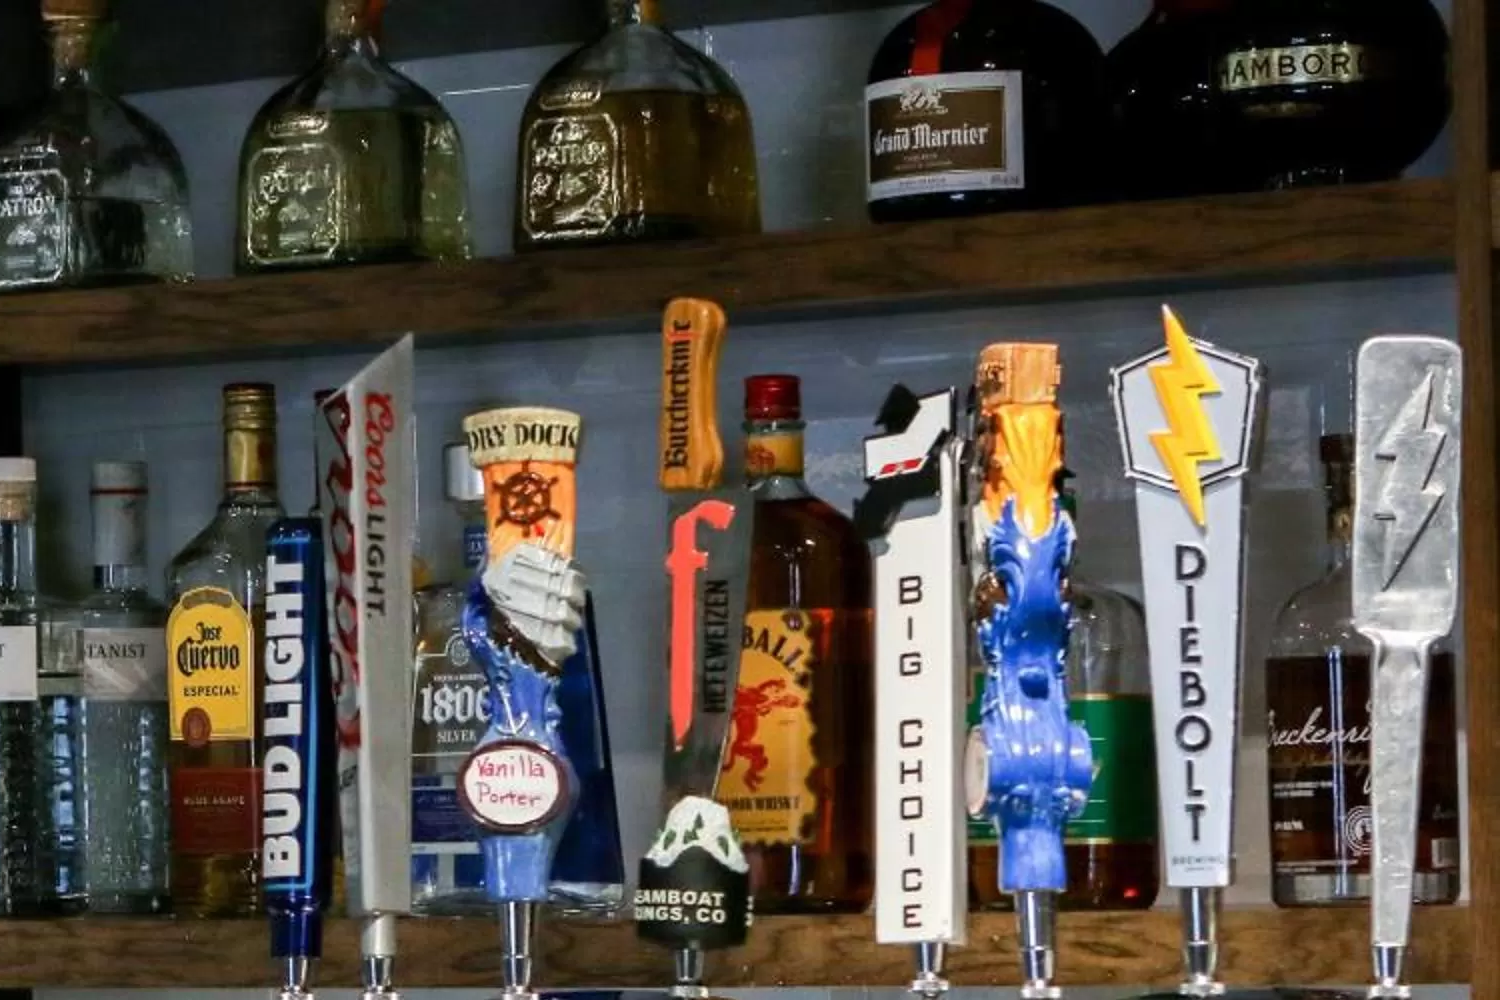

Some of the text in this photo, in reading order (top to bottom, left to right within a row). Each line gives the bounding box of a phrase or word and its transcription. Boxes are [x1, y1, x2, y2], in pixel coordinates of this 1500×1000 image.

[1218, 52, 1364, 84] AMBOR
[913, 123, 989, 149] Marnier
[364, 391, 394, 508] Coors
[468, 423, 580, 452] DRY DOCK
[195, 621, 222, 645] Jose
[703, 579, 728, 713] HEFEWEIZEN
[742, 624, 804, 673] BALL
[85, 642, 148, 660] TANIST
[177, 637, 240, 677] Cuervo
[183, 684, 238, 698] ESPECIAL
[1174, 543, 1212, 842] DIEBOLT
[263, 555, 304, 878] BUD LIGHT
[477, 754, 545, 778] Vanilla
[899, 576, 924, 930] BIG CHOICE
[474, 781, 542, 807] Porter
